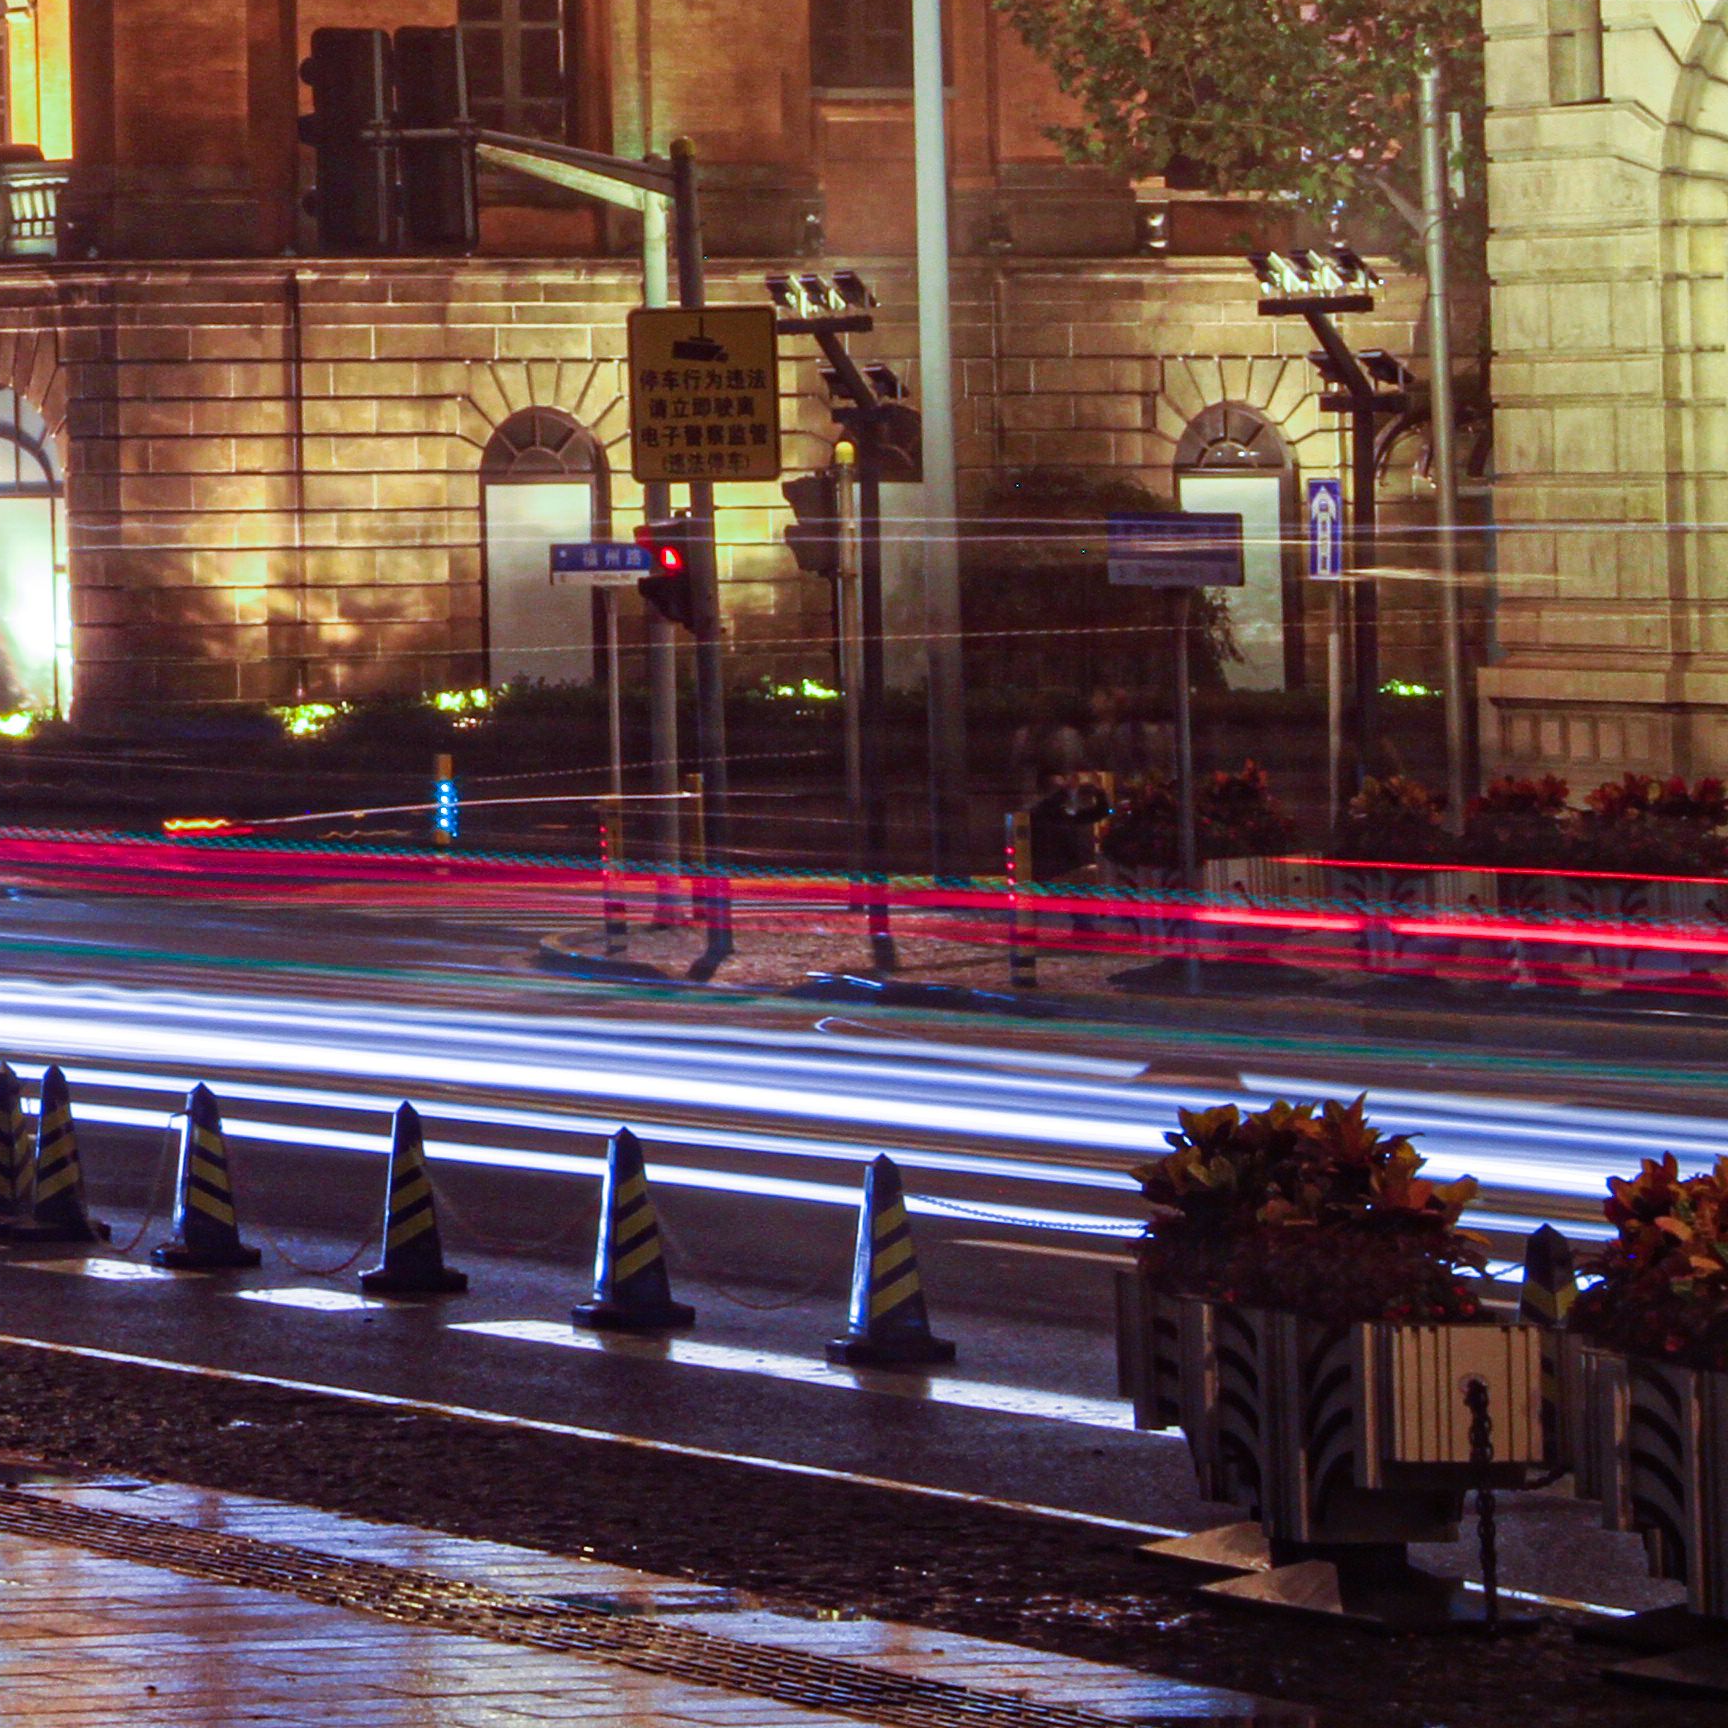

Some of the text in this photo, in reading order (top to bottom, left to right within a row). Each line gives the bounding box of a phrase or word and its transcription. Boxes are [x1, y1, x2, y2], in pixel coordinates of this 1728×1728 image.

[640, 369, 766, 391] 停车行为违法
